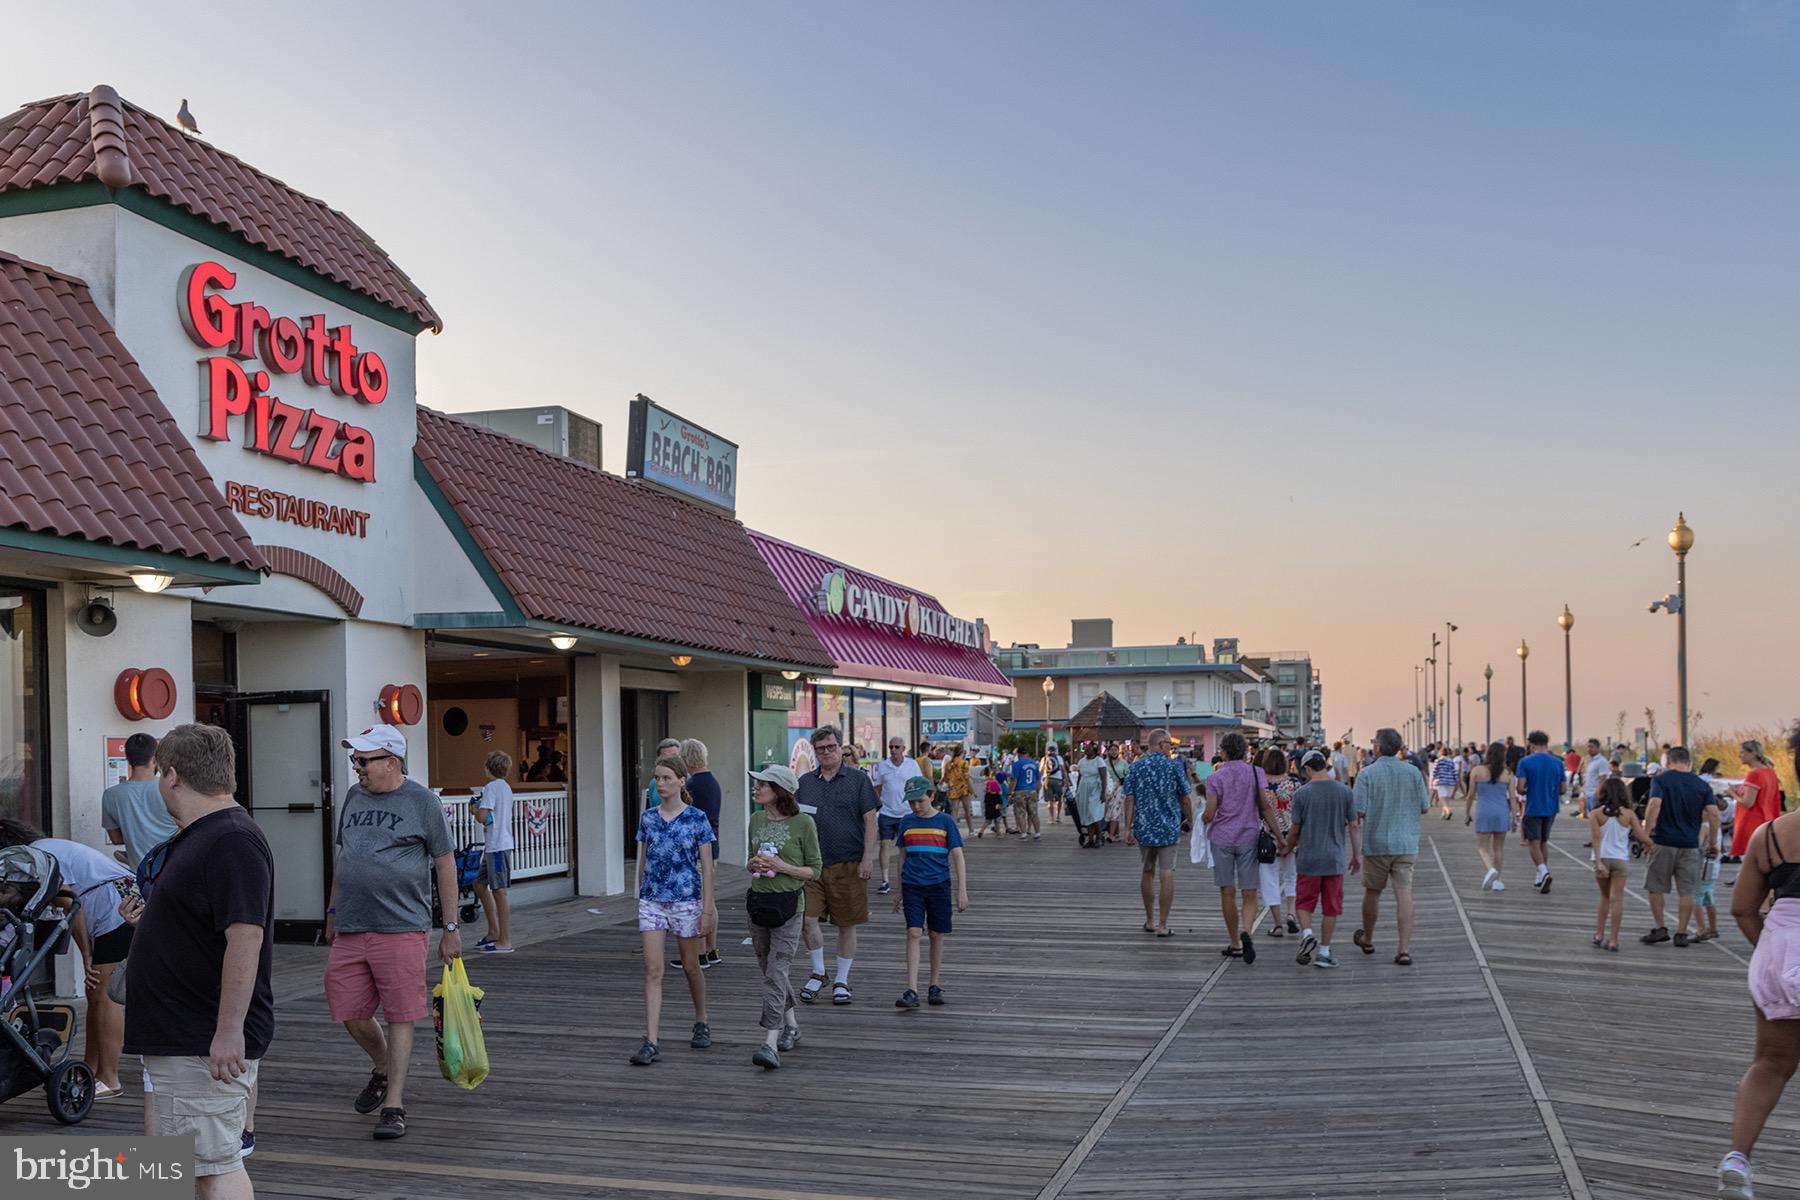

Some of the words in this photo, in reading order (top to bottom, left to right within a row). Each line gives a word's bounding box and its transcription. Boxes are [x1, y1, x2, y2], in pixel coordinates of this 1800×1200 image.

[177, 261, 388, 404] Grotto
[197, 357, 375, 483] Pizza
[681, 425, 709, 449] Grotto's
[652, 431, 700, 481] BEACH
[706, 455, 732, 494] BAR
[225, 480, 370, 538] RESTAURANT
[847, 584, 909, 629] CANDY
[919, 606, 983, 649] KITCHEN
[937, 721, 966, 734] BROS
[1026, 769, 1033, 784] 9
[345, 810, 404, 831] NAVY
